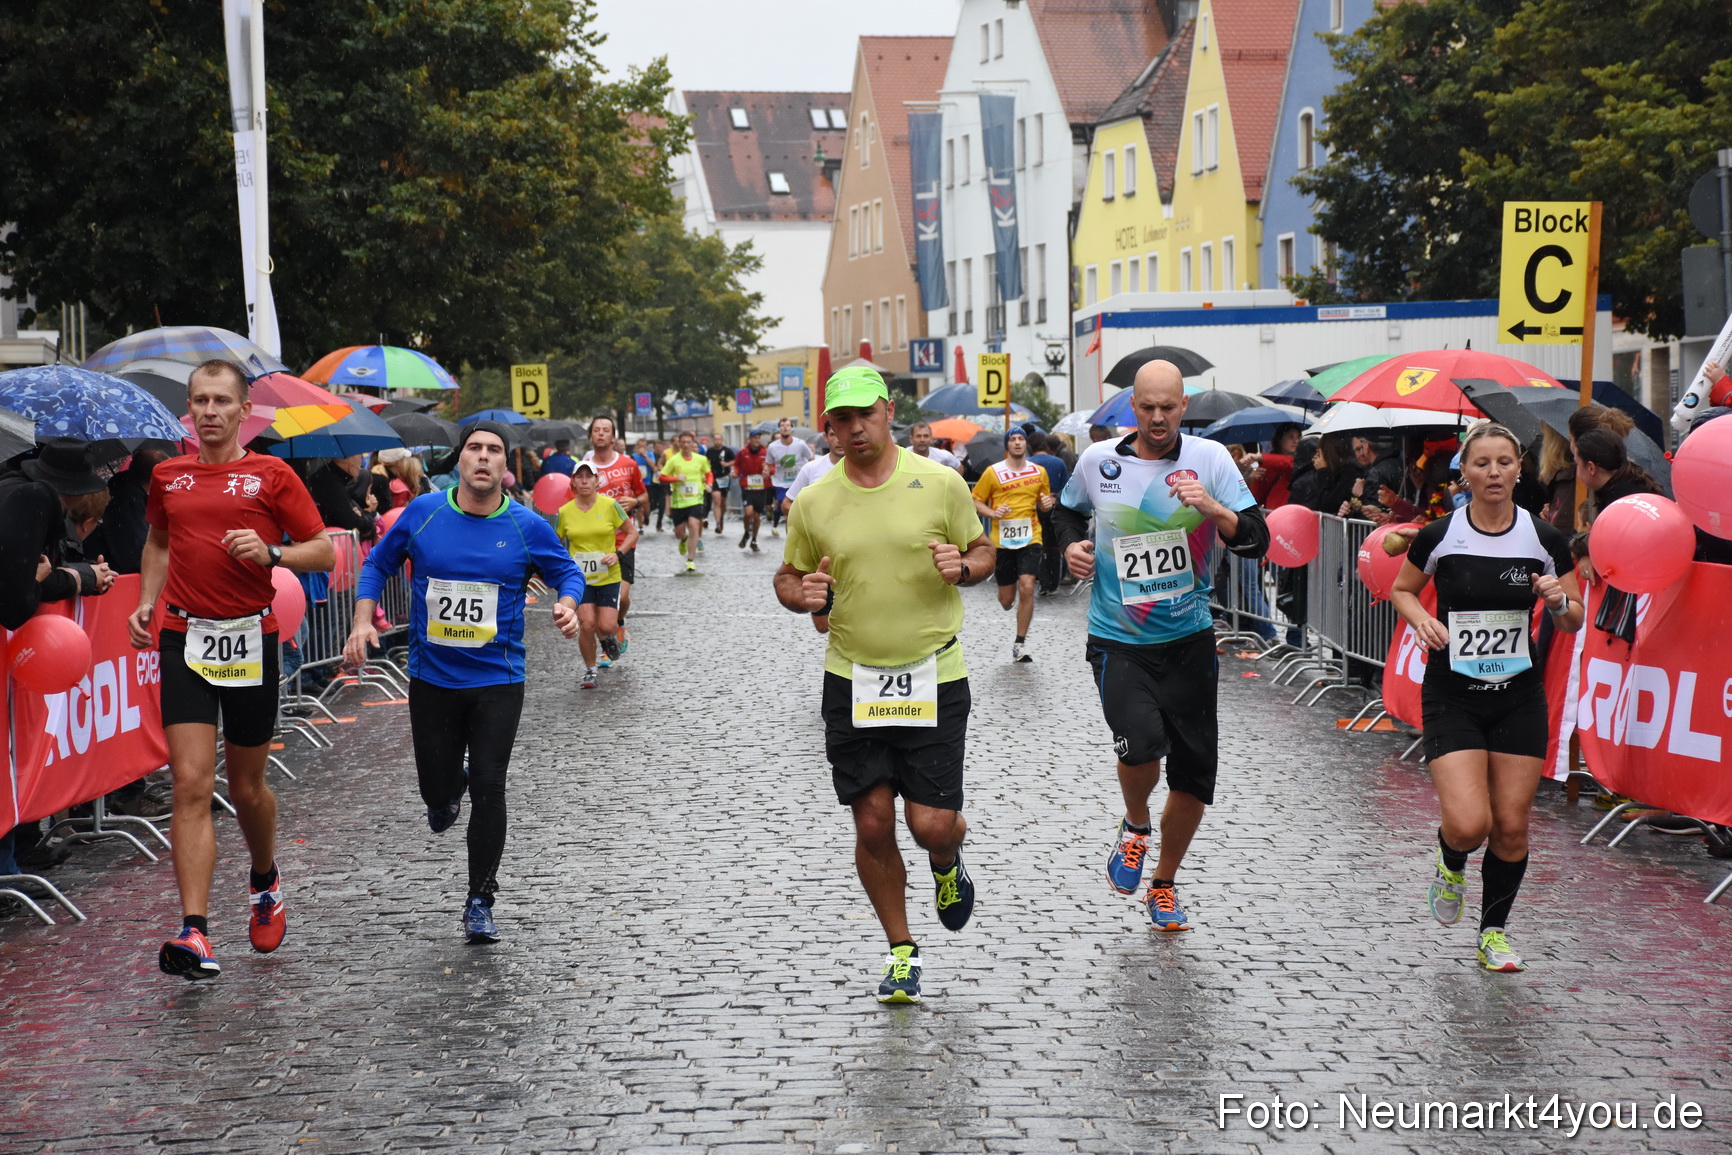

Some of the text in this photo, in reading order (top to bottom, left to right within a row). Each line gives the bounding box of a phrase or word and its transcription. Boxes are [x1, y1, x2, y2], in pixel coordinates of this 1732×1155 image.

[1514, 208, 1589, 233] Block
[1524, 244, 1574, 315] C
[981, 355, 1007, 366] Block
[515, 367, 543, 378] Block
[986, 370, 1002, 395] D
[521, 381, 540, 407] D
[1002, 482, 1021, 492] MAX
[1003, 526, 1029, 539] 2817
[1146, 532, 1183, 544] BOCK
[581, 560, 597, 573] 70
[1124, 545, 1187, 578] 2120
[456, 583, 492, 593] BOCK
[1139, 579, 1178, 593] Andreas
[438, 596, 484, 623] 245
[1485, 612, 1523, 623] BOCK
[443, 627, 475, 639] Martin
[202, 633, 249, 662] 204
[1458, 628, 1522, 656] 2227
[201, 666, 247, 679] Christian
[1478, 661, 1505, 674] Kathi
[878, 672, 913, 698] 29
[868, 704, 922, 717] Alexander
